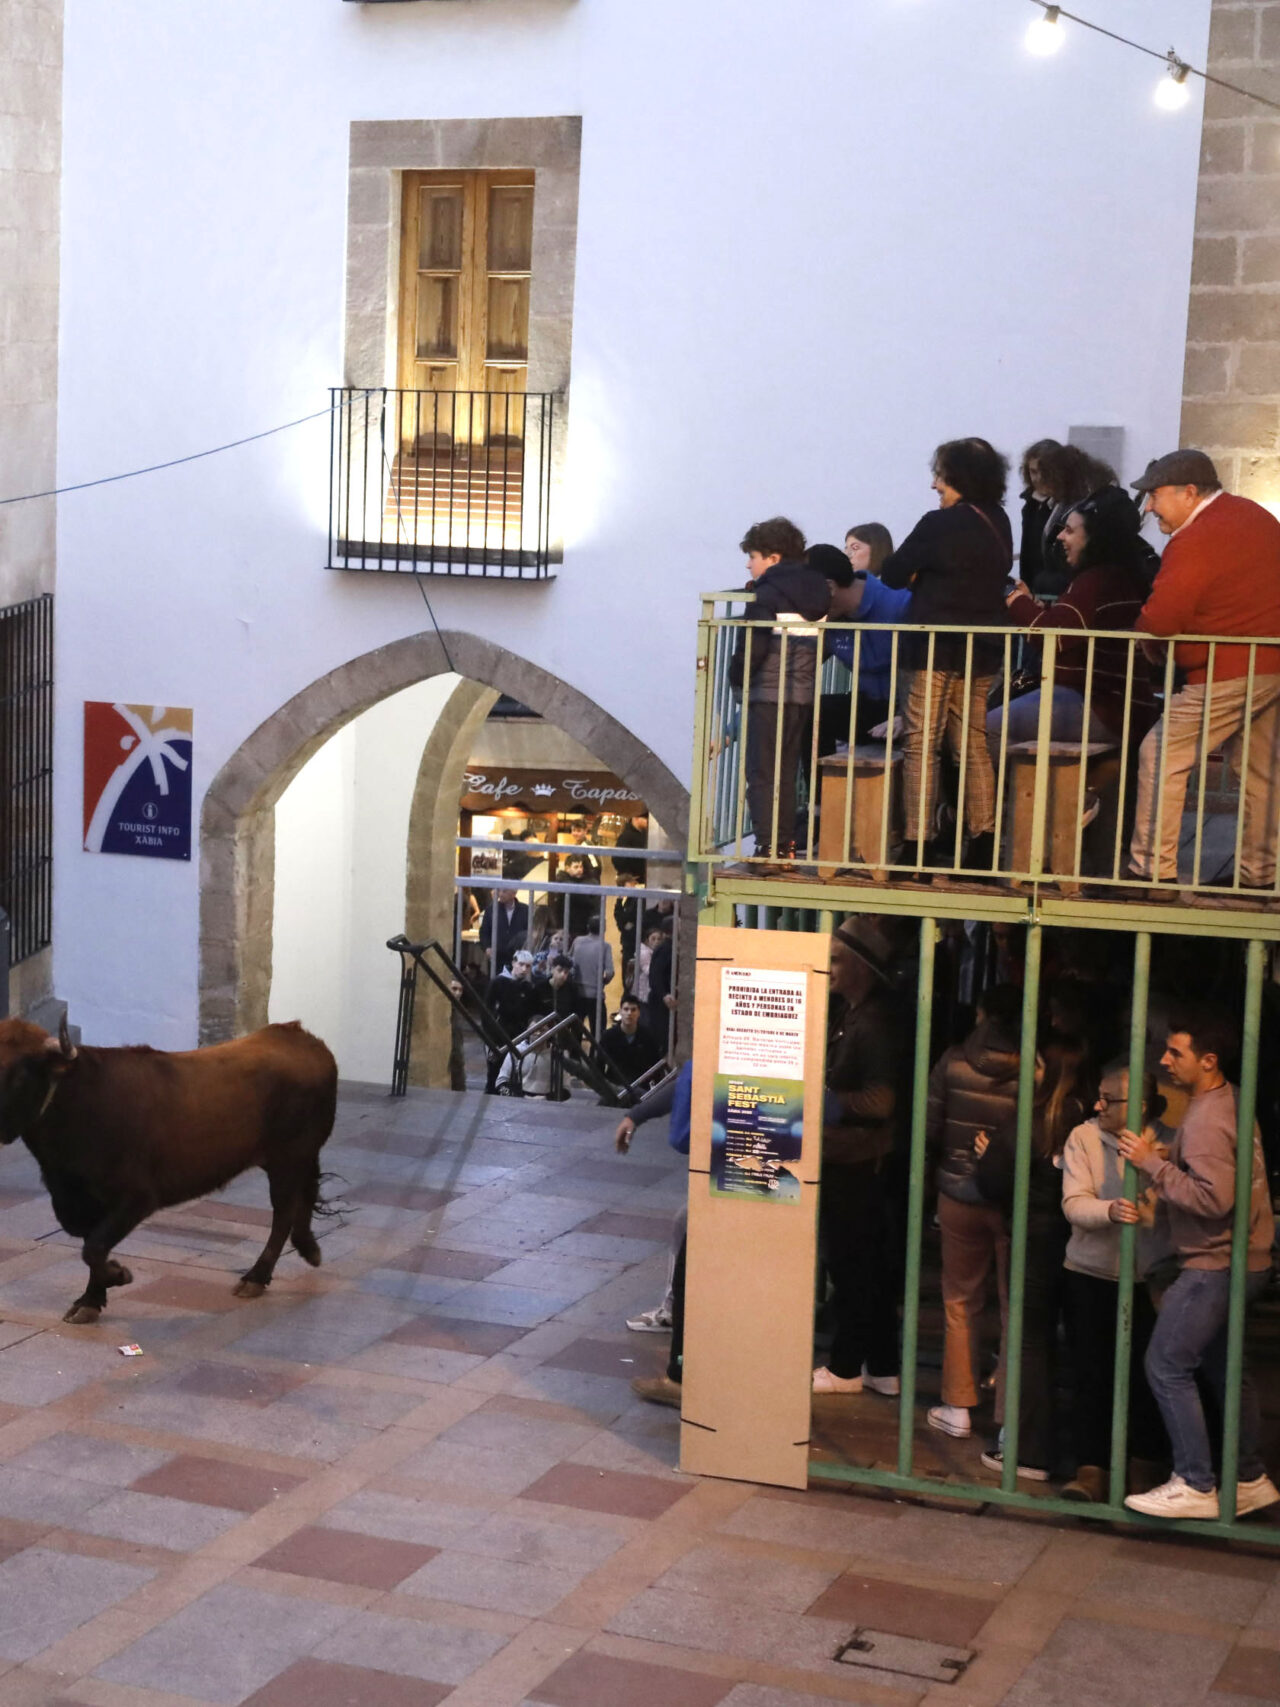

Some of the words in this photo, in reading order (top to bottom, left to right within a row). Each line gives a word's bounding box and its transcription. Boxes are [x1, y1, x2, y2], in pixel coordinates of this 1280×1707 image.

[463, 772, 523, 801] Cafe
[562, 779, 641, 806] Tapas
[118, 822, 156, 834] TOURIST
[158, 825, 180, 836] INFO
[728, 985, 759, 993] PROHIBIDA
[769, 988, 794, 996] ENTRADA
[728, 993, 752, 1001] RECINTO
[759, 995, 785, 1003] MENORES
[735, 1000, 750, 1008] AÑOS
[756, 1003, 786, 1011] PERSONAS
[762, 1011, 798, 1020] EMBRIAGUEZ
[728, 1084, 760, 1094] SANT
[728, 1099, 758, 1108] FEST
